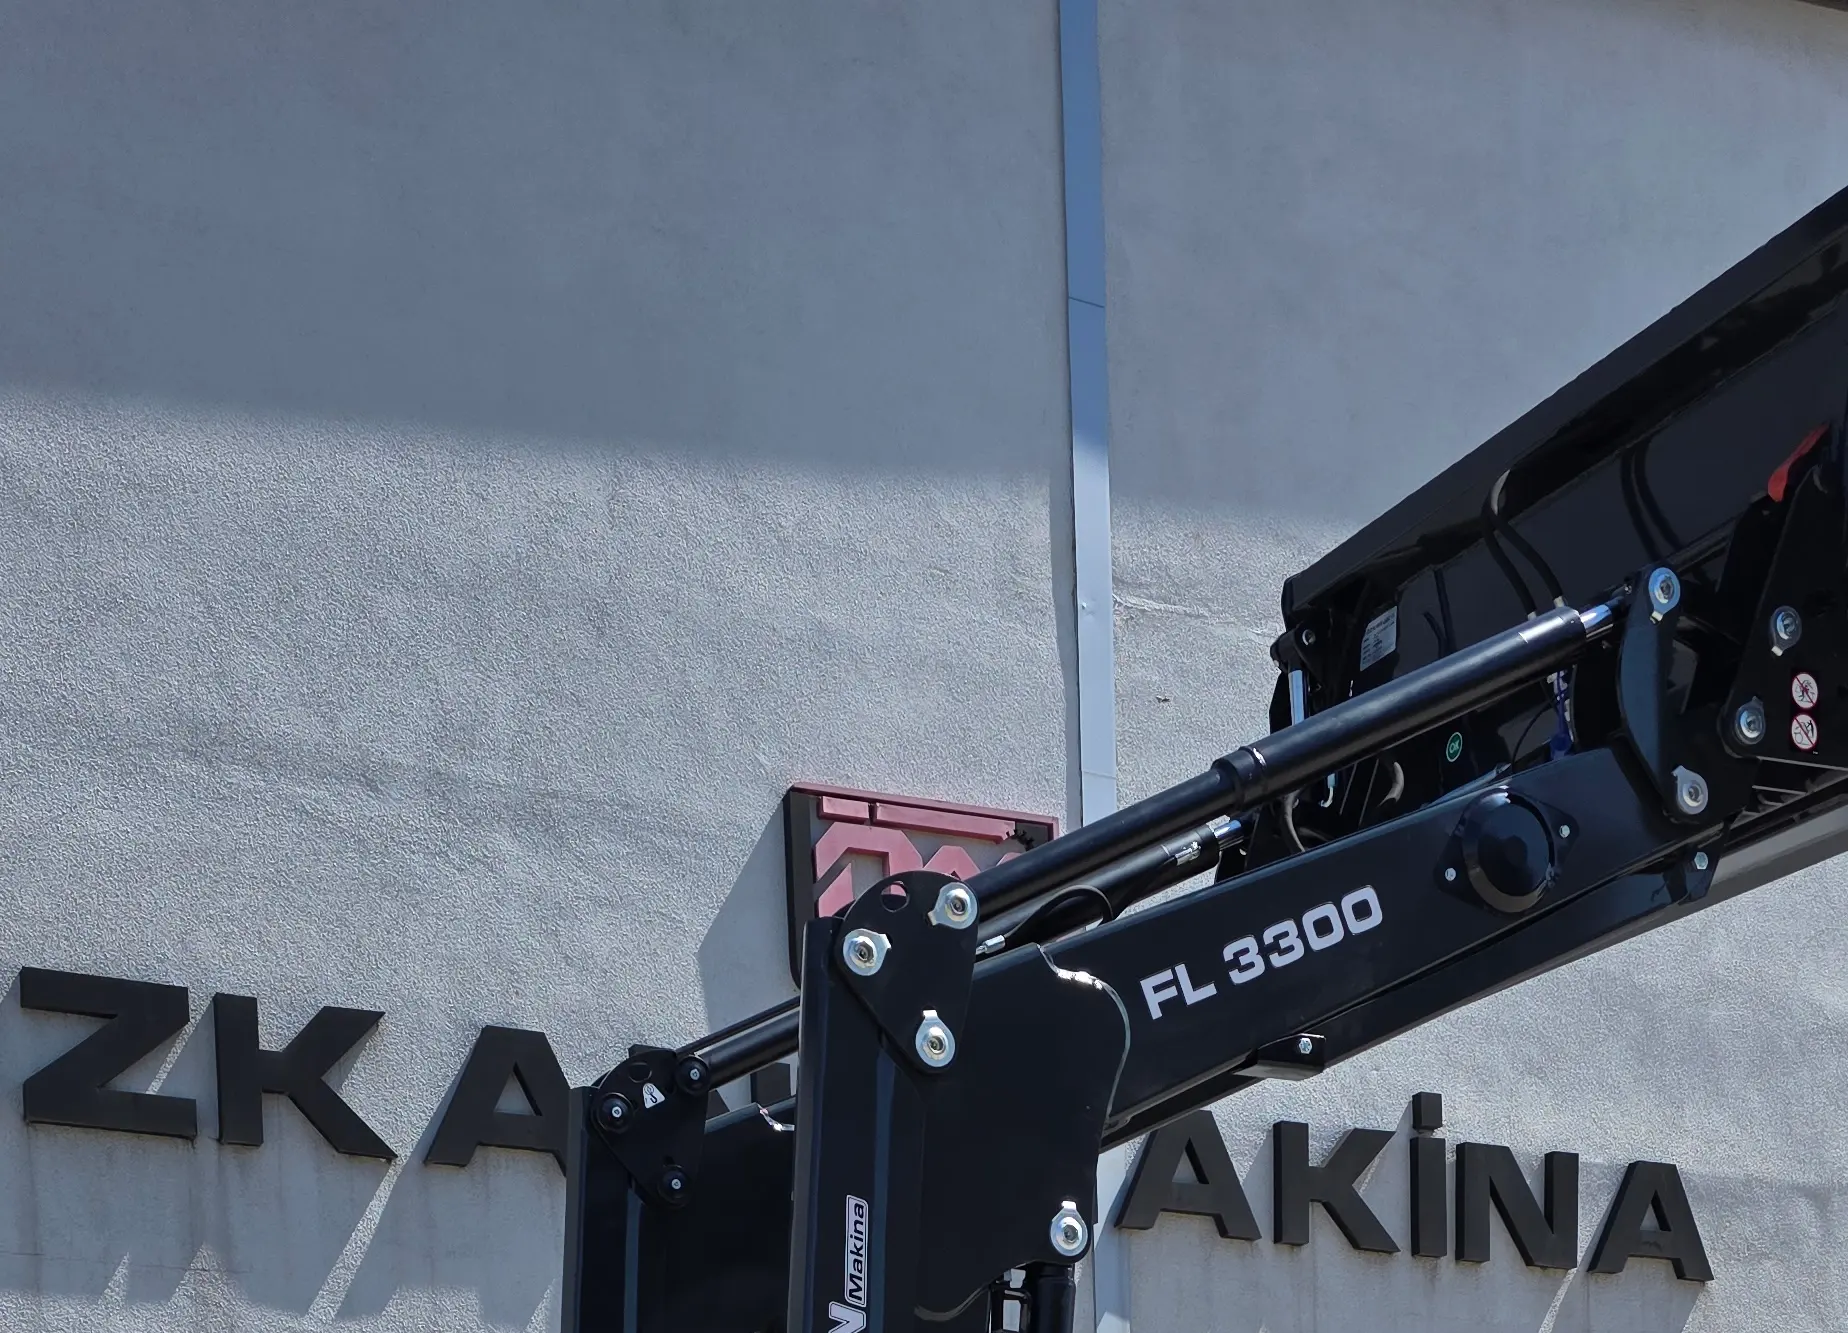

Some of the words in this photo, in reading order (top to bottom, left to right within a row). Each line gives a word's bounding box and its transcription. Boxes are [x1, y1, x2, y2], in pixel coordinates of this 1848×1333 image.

[1139, 961, 1217, 1020] FL
[1222, 884, 1383, 985] 3300
[848, 1202, 865, 1301] Makina
